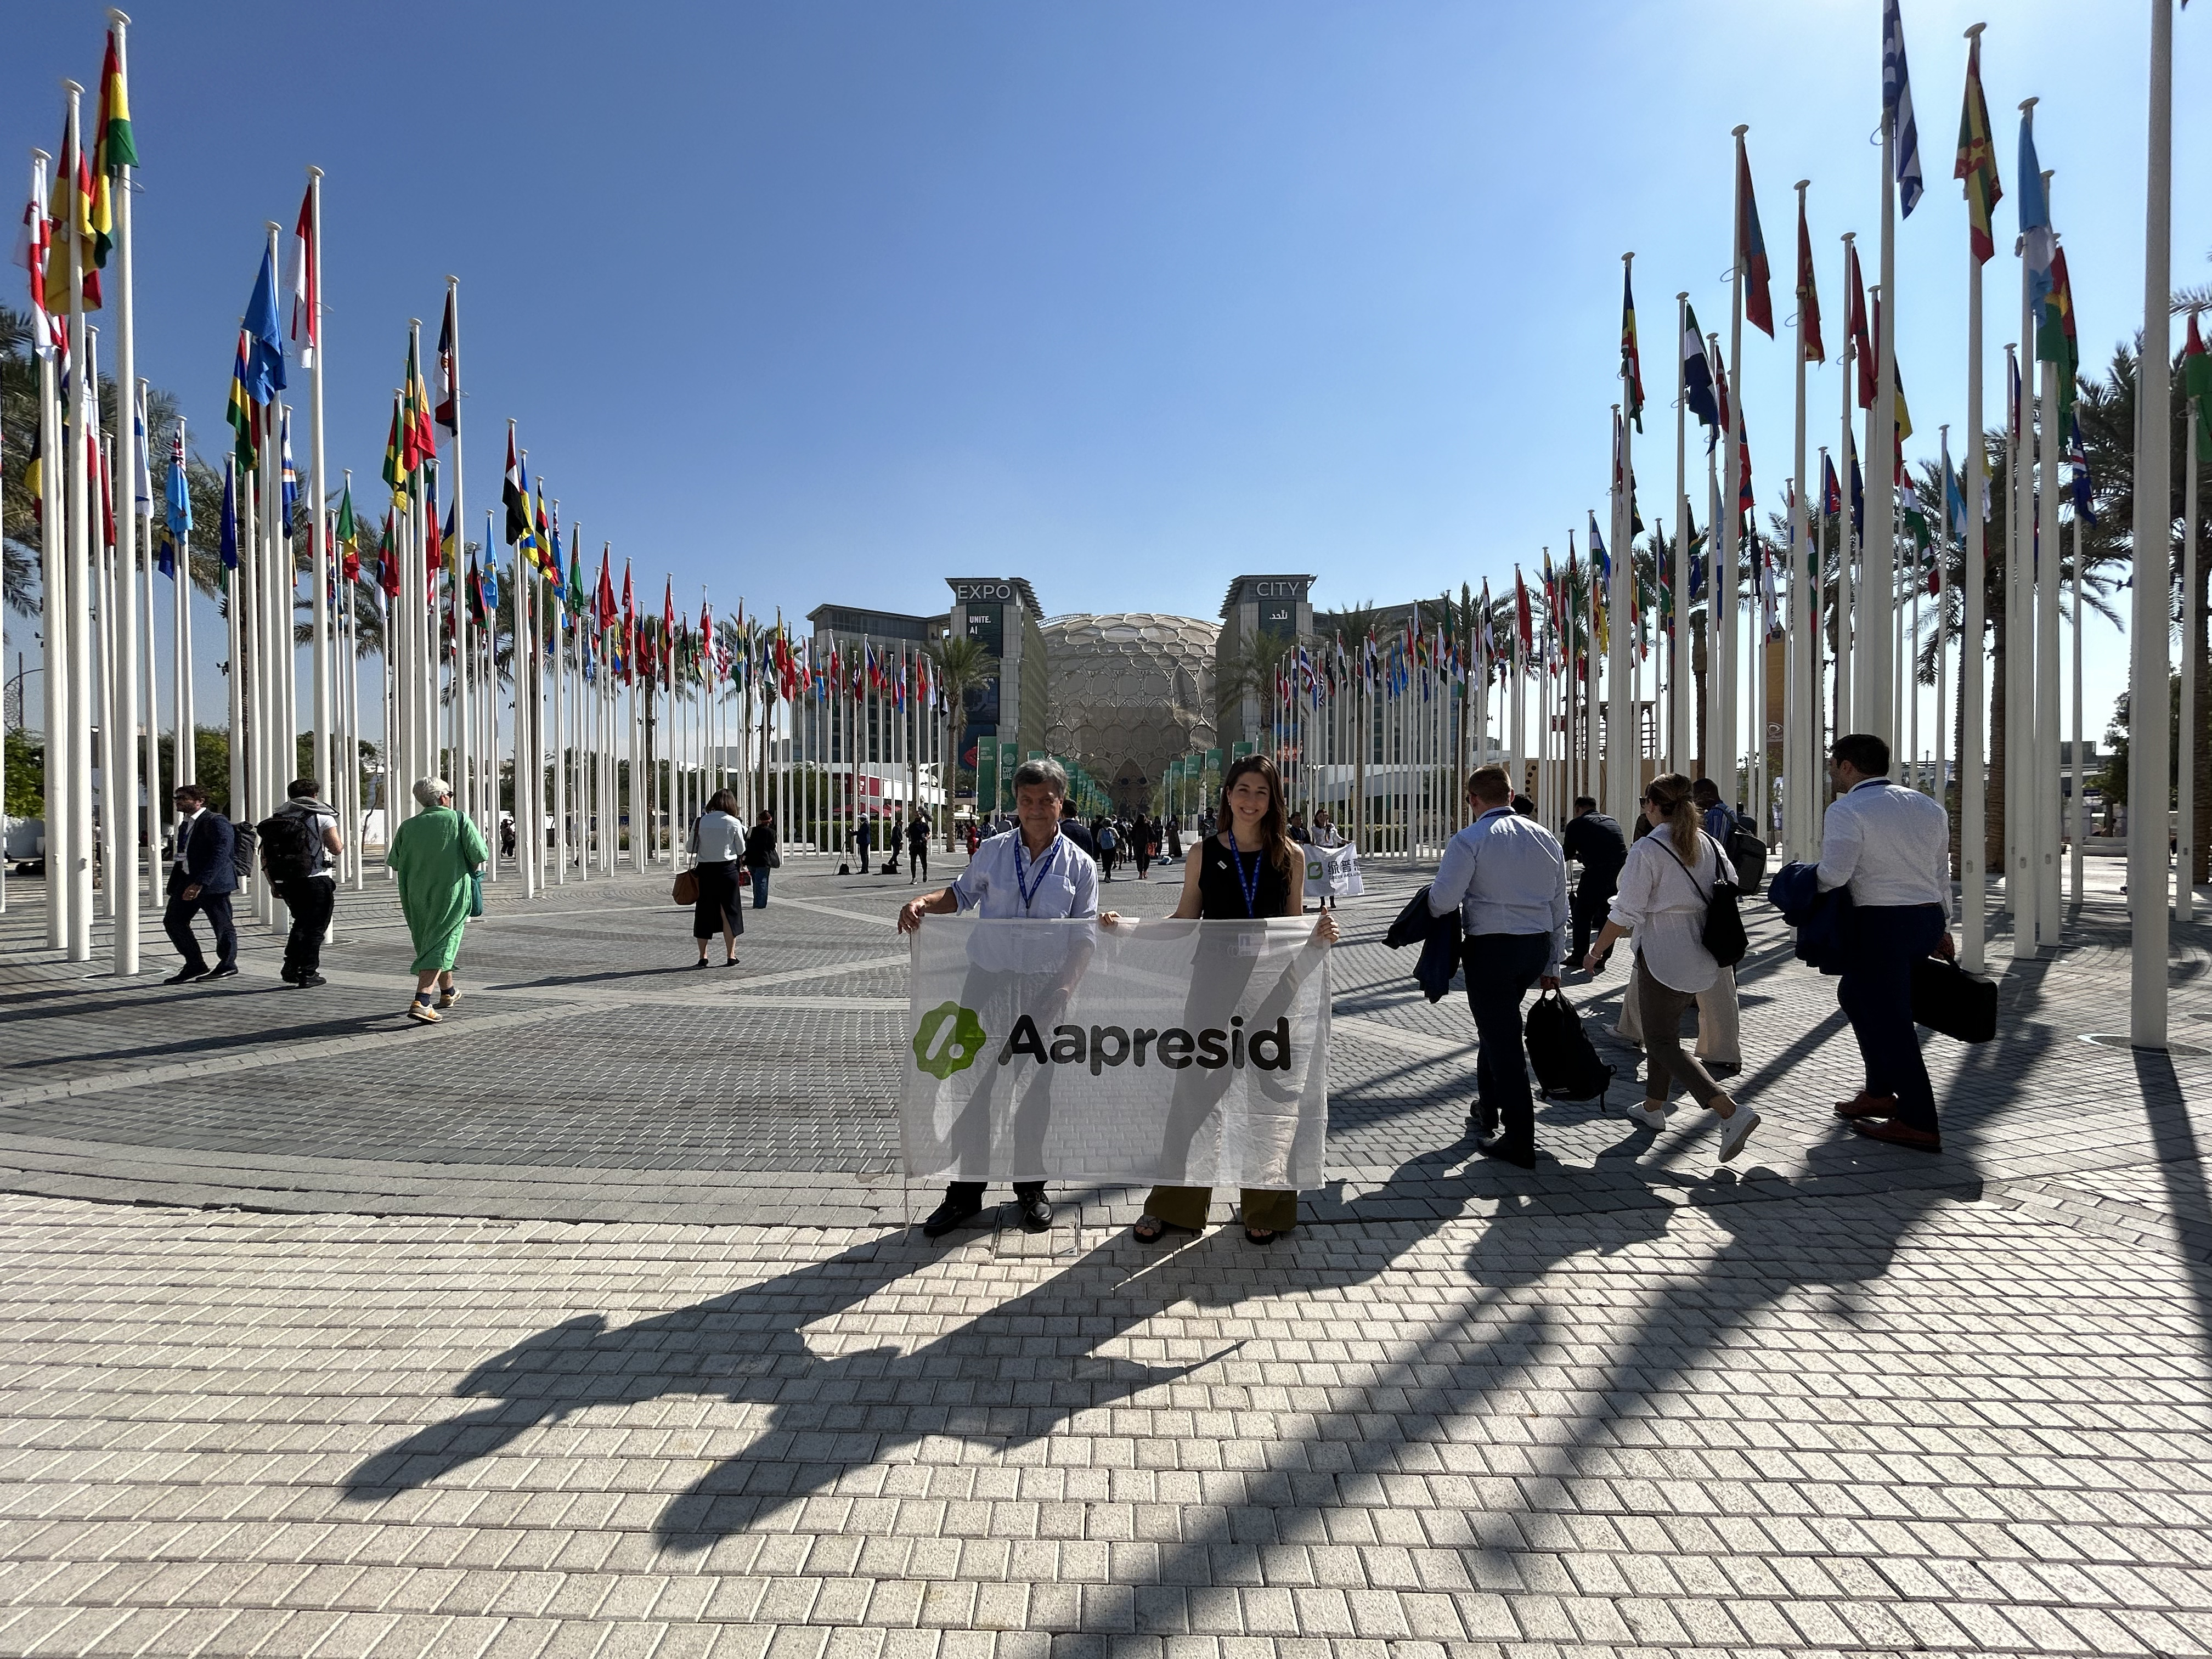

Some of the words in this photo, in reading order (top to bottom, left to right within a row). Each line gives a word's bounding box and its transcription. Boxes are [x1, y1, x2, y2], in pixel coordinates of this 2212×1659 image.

[958, 585, 1011, 599] EXPO
[1256, 582, 1300, 596] CITY
[997, 1014, 1291, 1076] Aapresid
